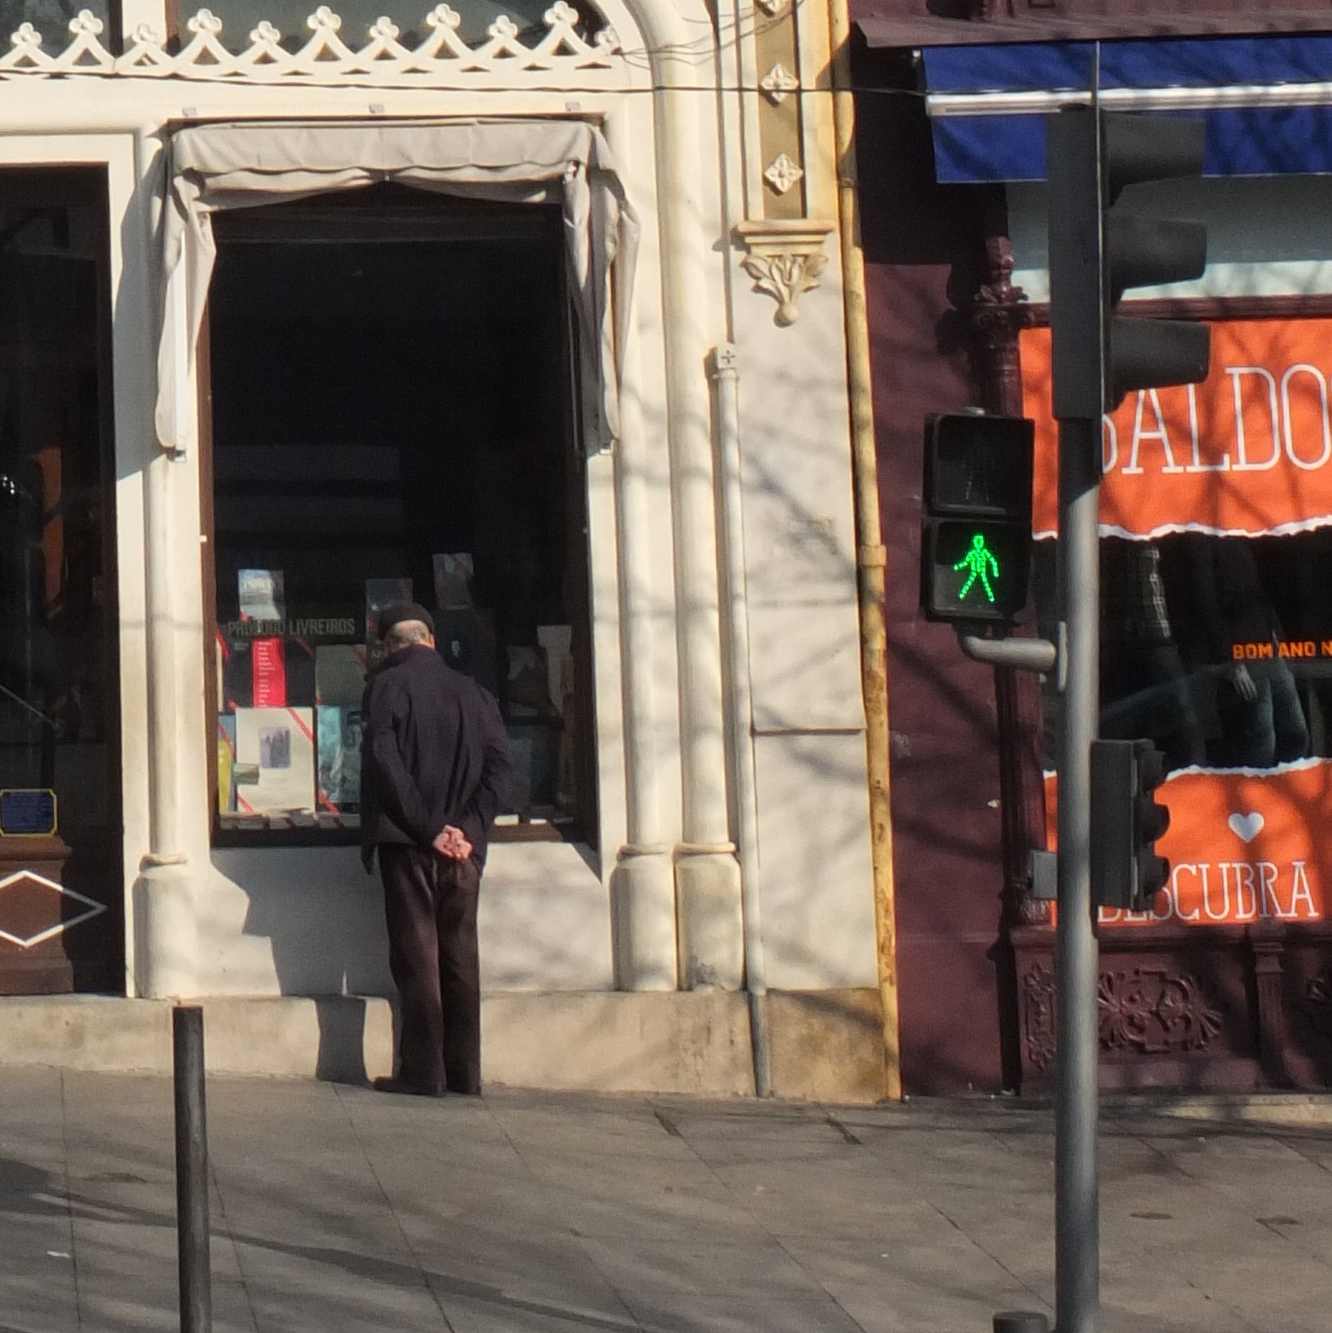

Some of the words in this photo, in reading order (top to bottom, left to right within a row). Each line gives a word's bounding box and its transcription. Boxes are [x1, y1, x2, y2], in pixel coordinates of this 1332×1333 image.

[1102, 364, 1332, 475] ALDO
[1232, 642, 1274, 660] BOM
[1278, 640, 1317, 658] ANO
[1097, 861, 1319, 923] SCUBRA
